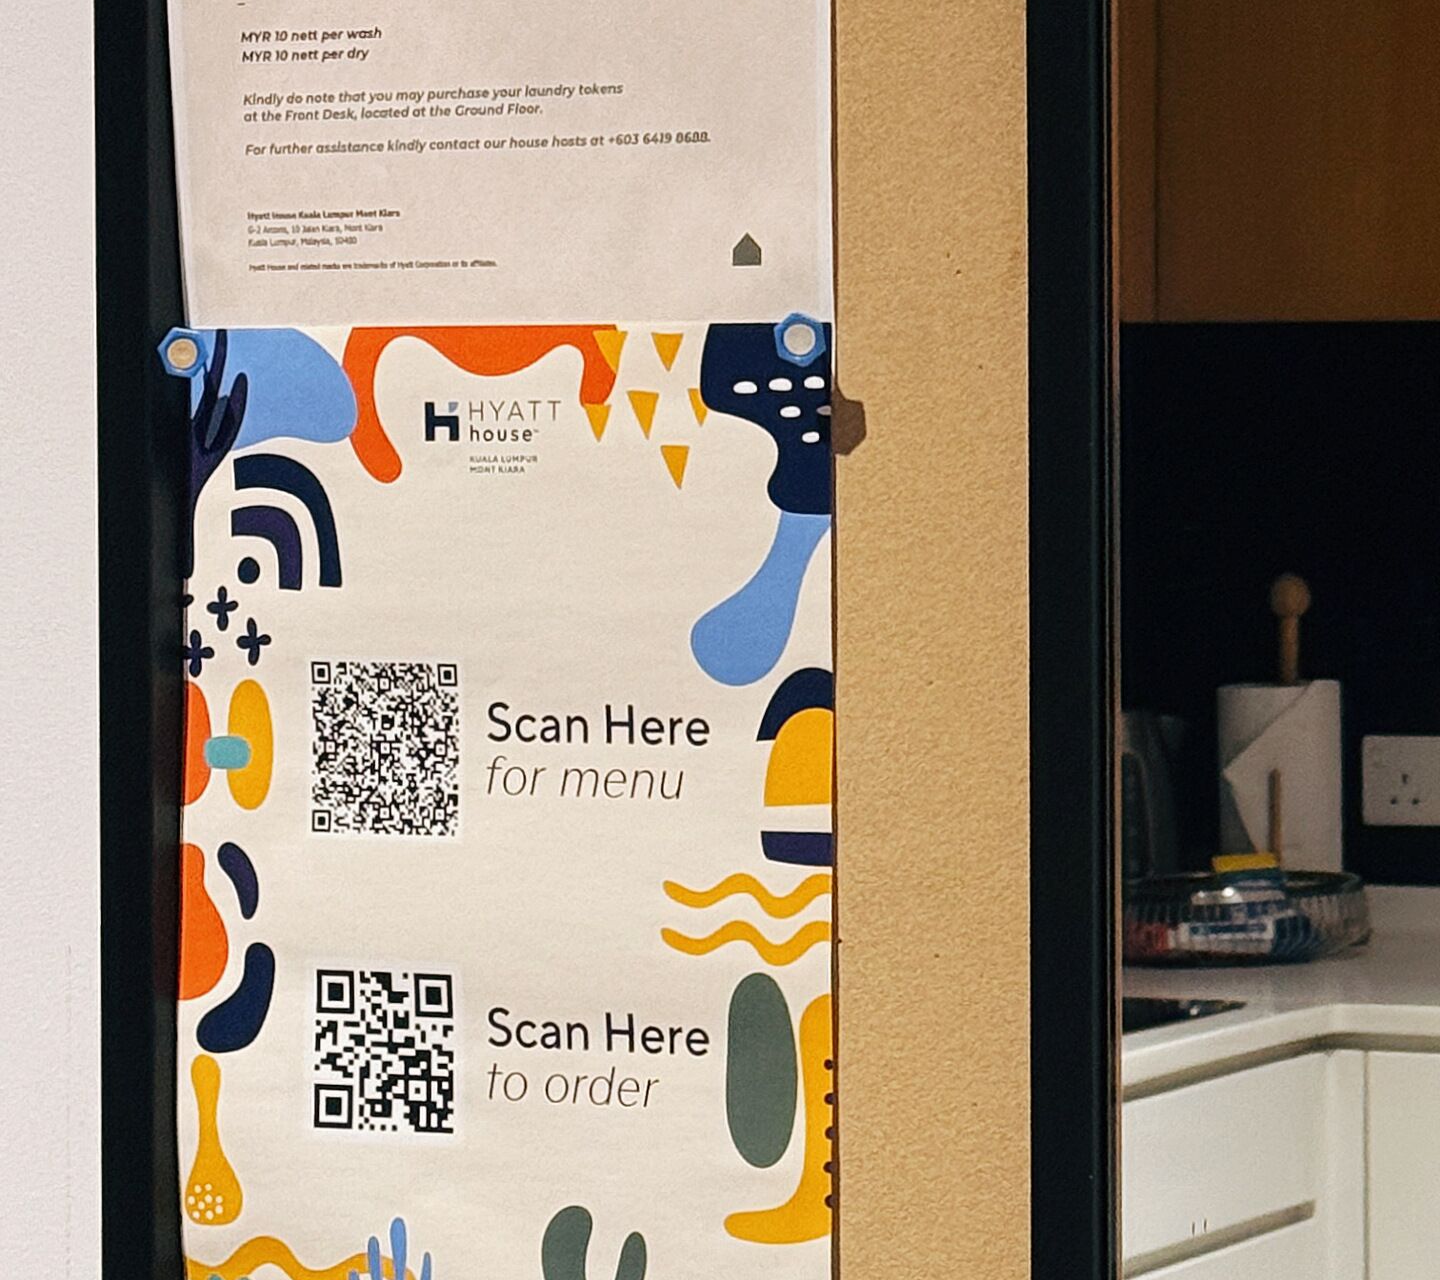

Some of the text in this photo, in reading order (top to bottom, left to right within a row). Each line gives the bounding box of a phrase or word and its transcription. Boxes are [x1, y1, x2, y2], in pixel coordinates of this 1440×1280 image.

[240, 30, 272, 43] MYR
[290, 30, 318, 41] nett
[320, 30, 344, 43] per
[346, 26, 382, 39] wash
[469, 401, 561, 421] HYATT
[487, 701, 710, 746] Scan Here
[487, 755, 684, 800] for menu
[488, 1006, 710, 1056] Scan Here
[487, 1062, 660, 1108] to order
